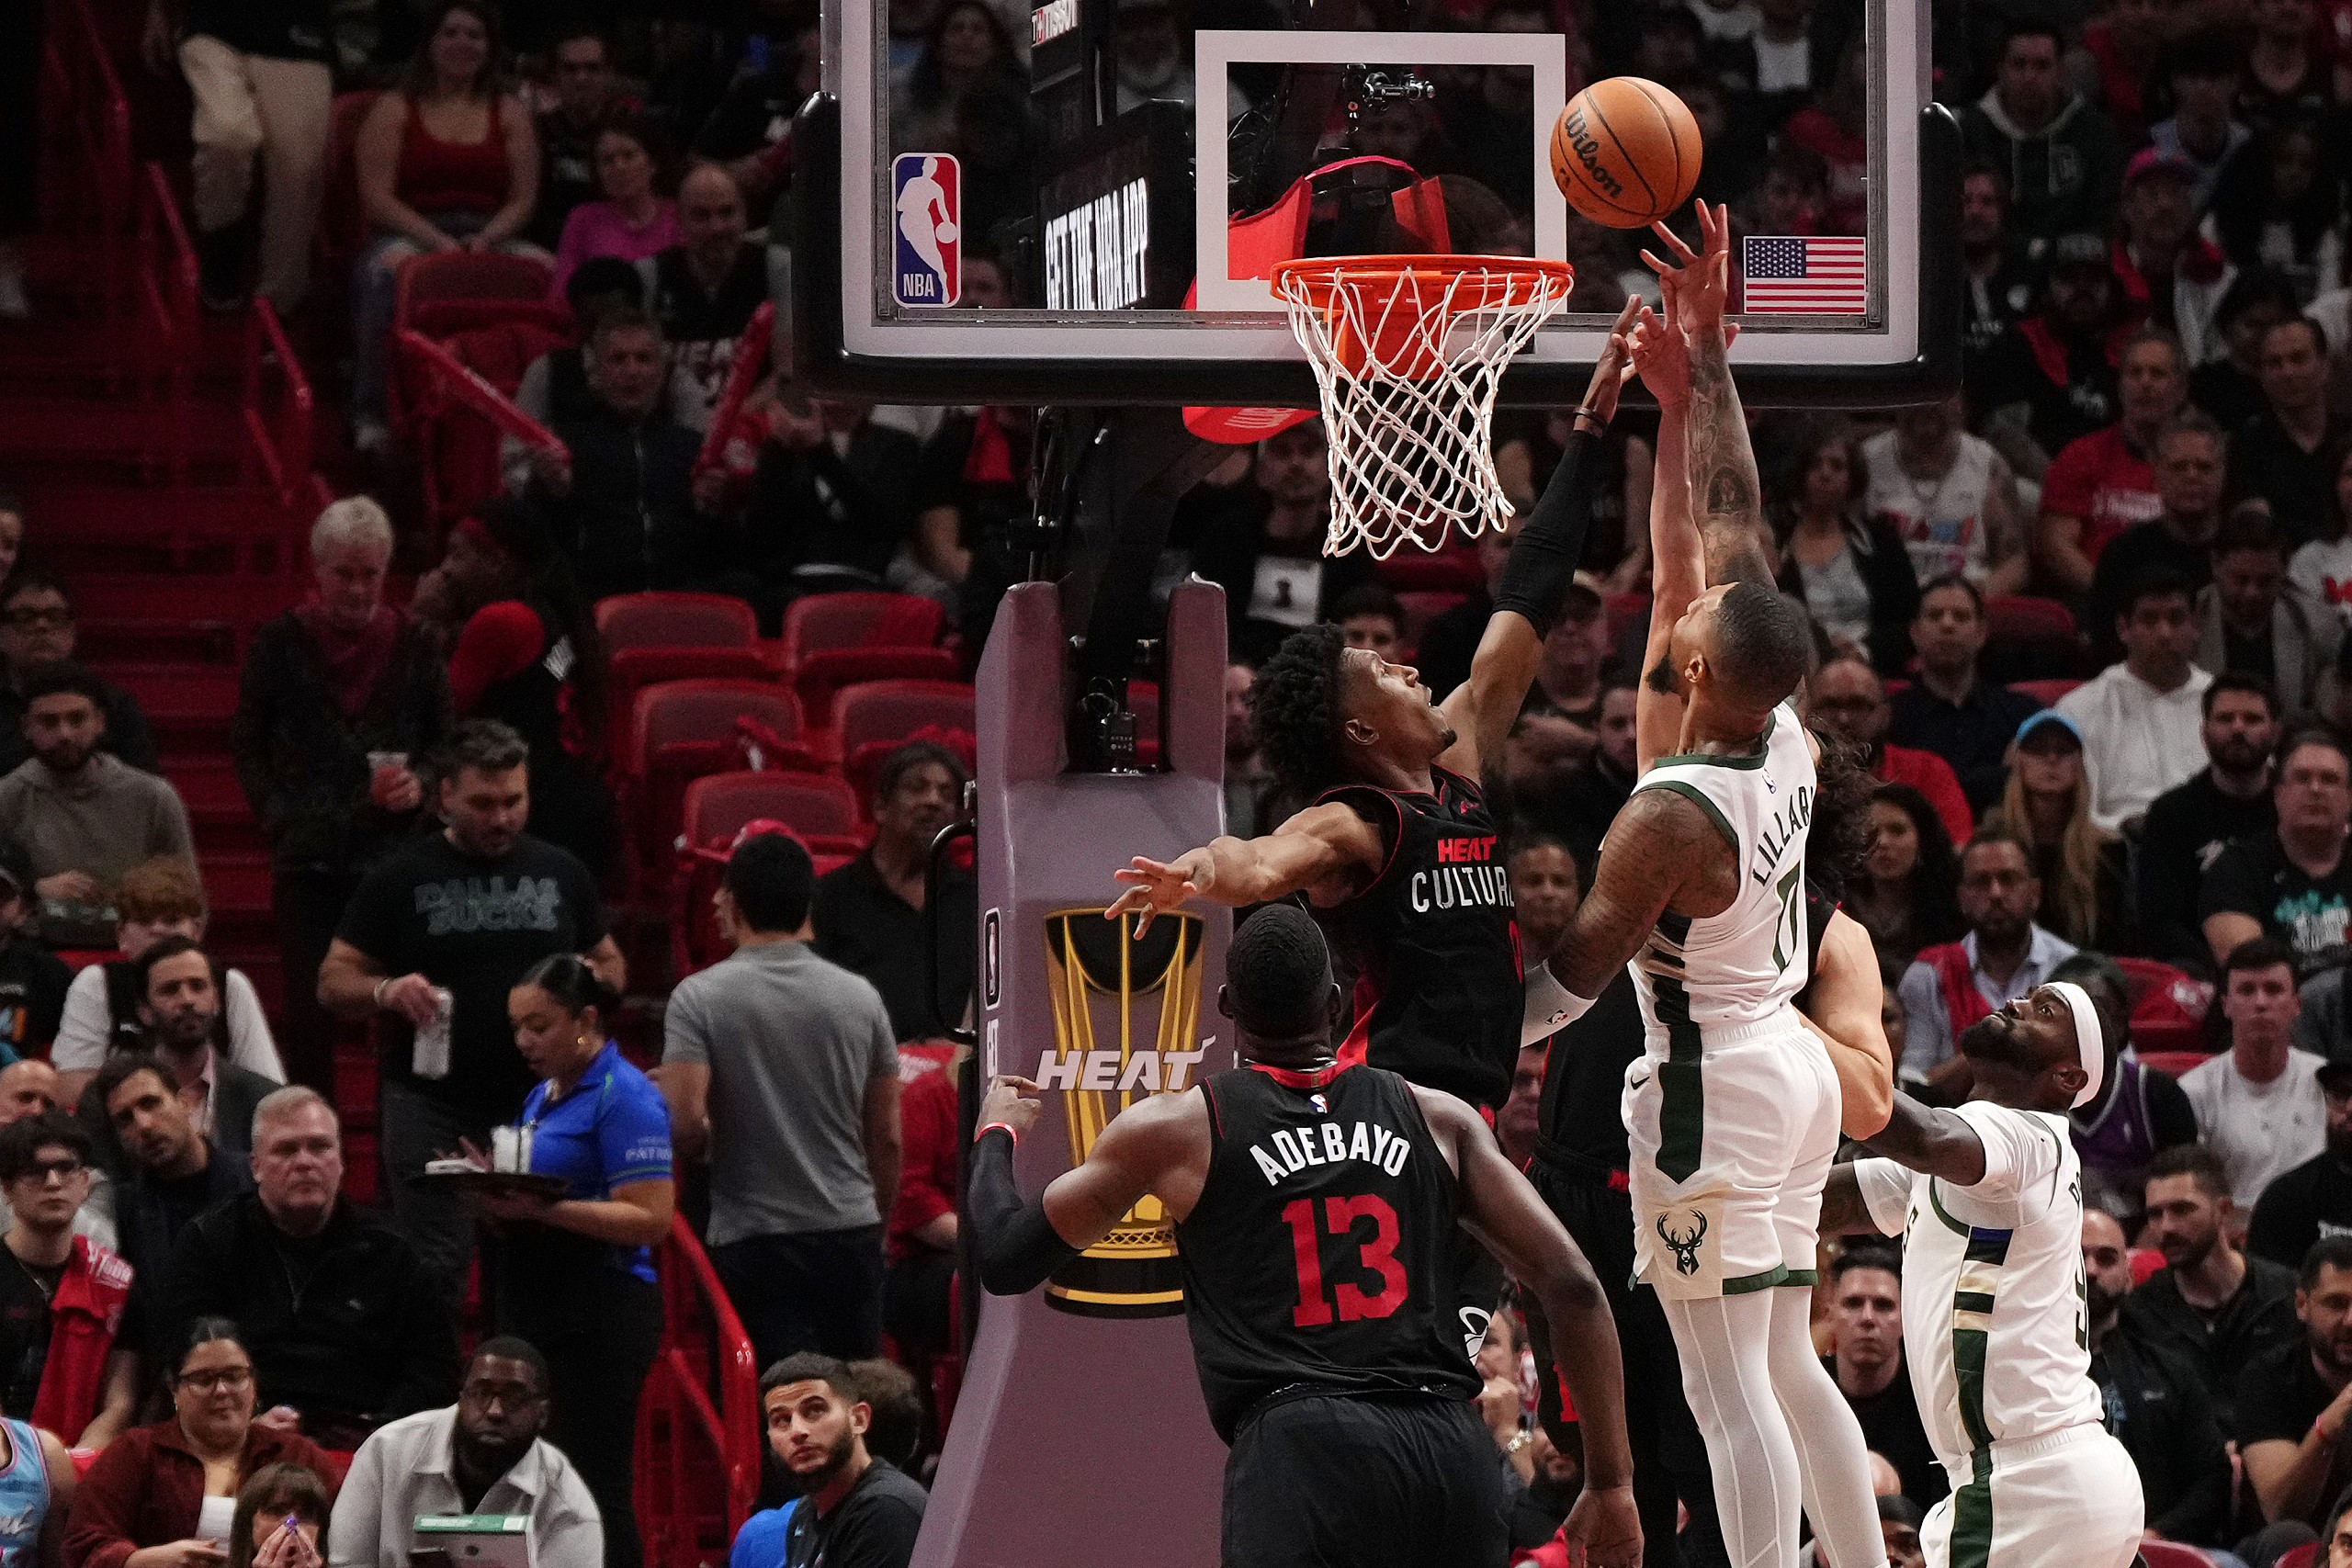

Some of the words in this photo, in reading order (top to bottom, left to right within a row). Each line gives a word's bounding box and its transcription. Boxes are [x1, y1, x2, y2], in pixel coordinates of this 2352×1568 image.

[1565, 107, 1623, 198] Wilson
[1123, 176, 1148, 306] APP
[903, 273, 934, 297] NBA
[1437, 835, 1498, 863] HEAT
[1752, 785, 1814, 887] LILLAR
[1035, 1034, 1217, 1091] HEAT
[1249, 1121, 1411, 1187] ADEBAYO
[1281, 1193, 1409, 1327] 13
